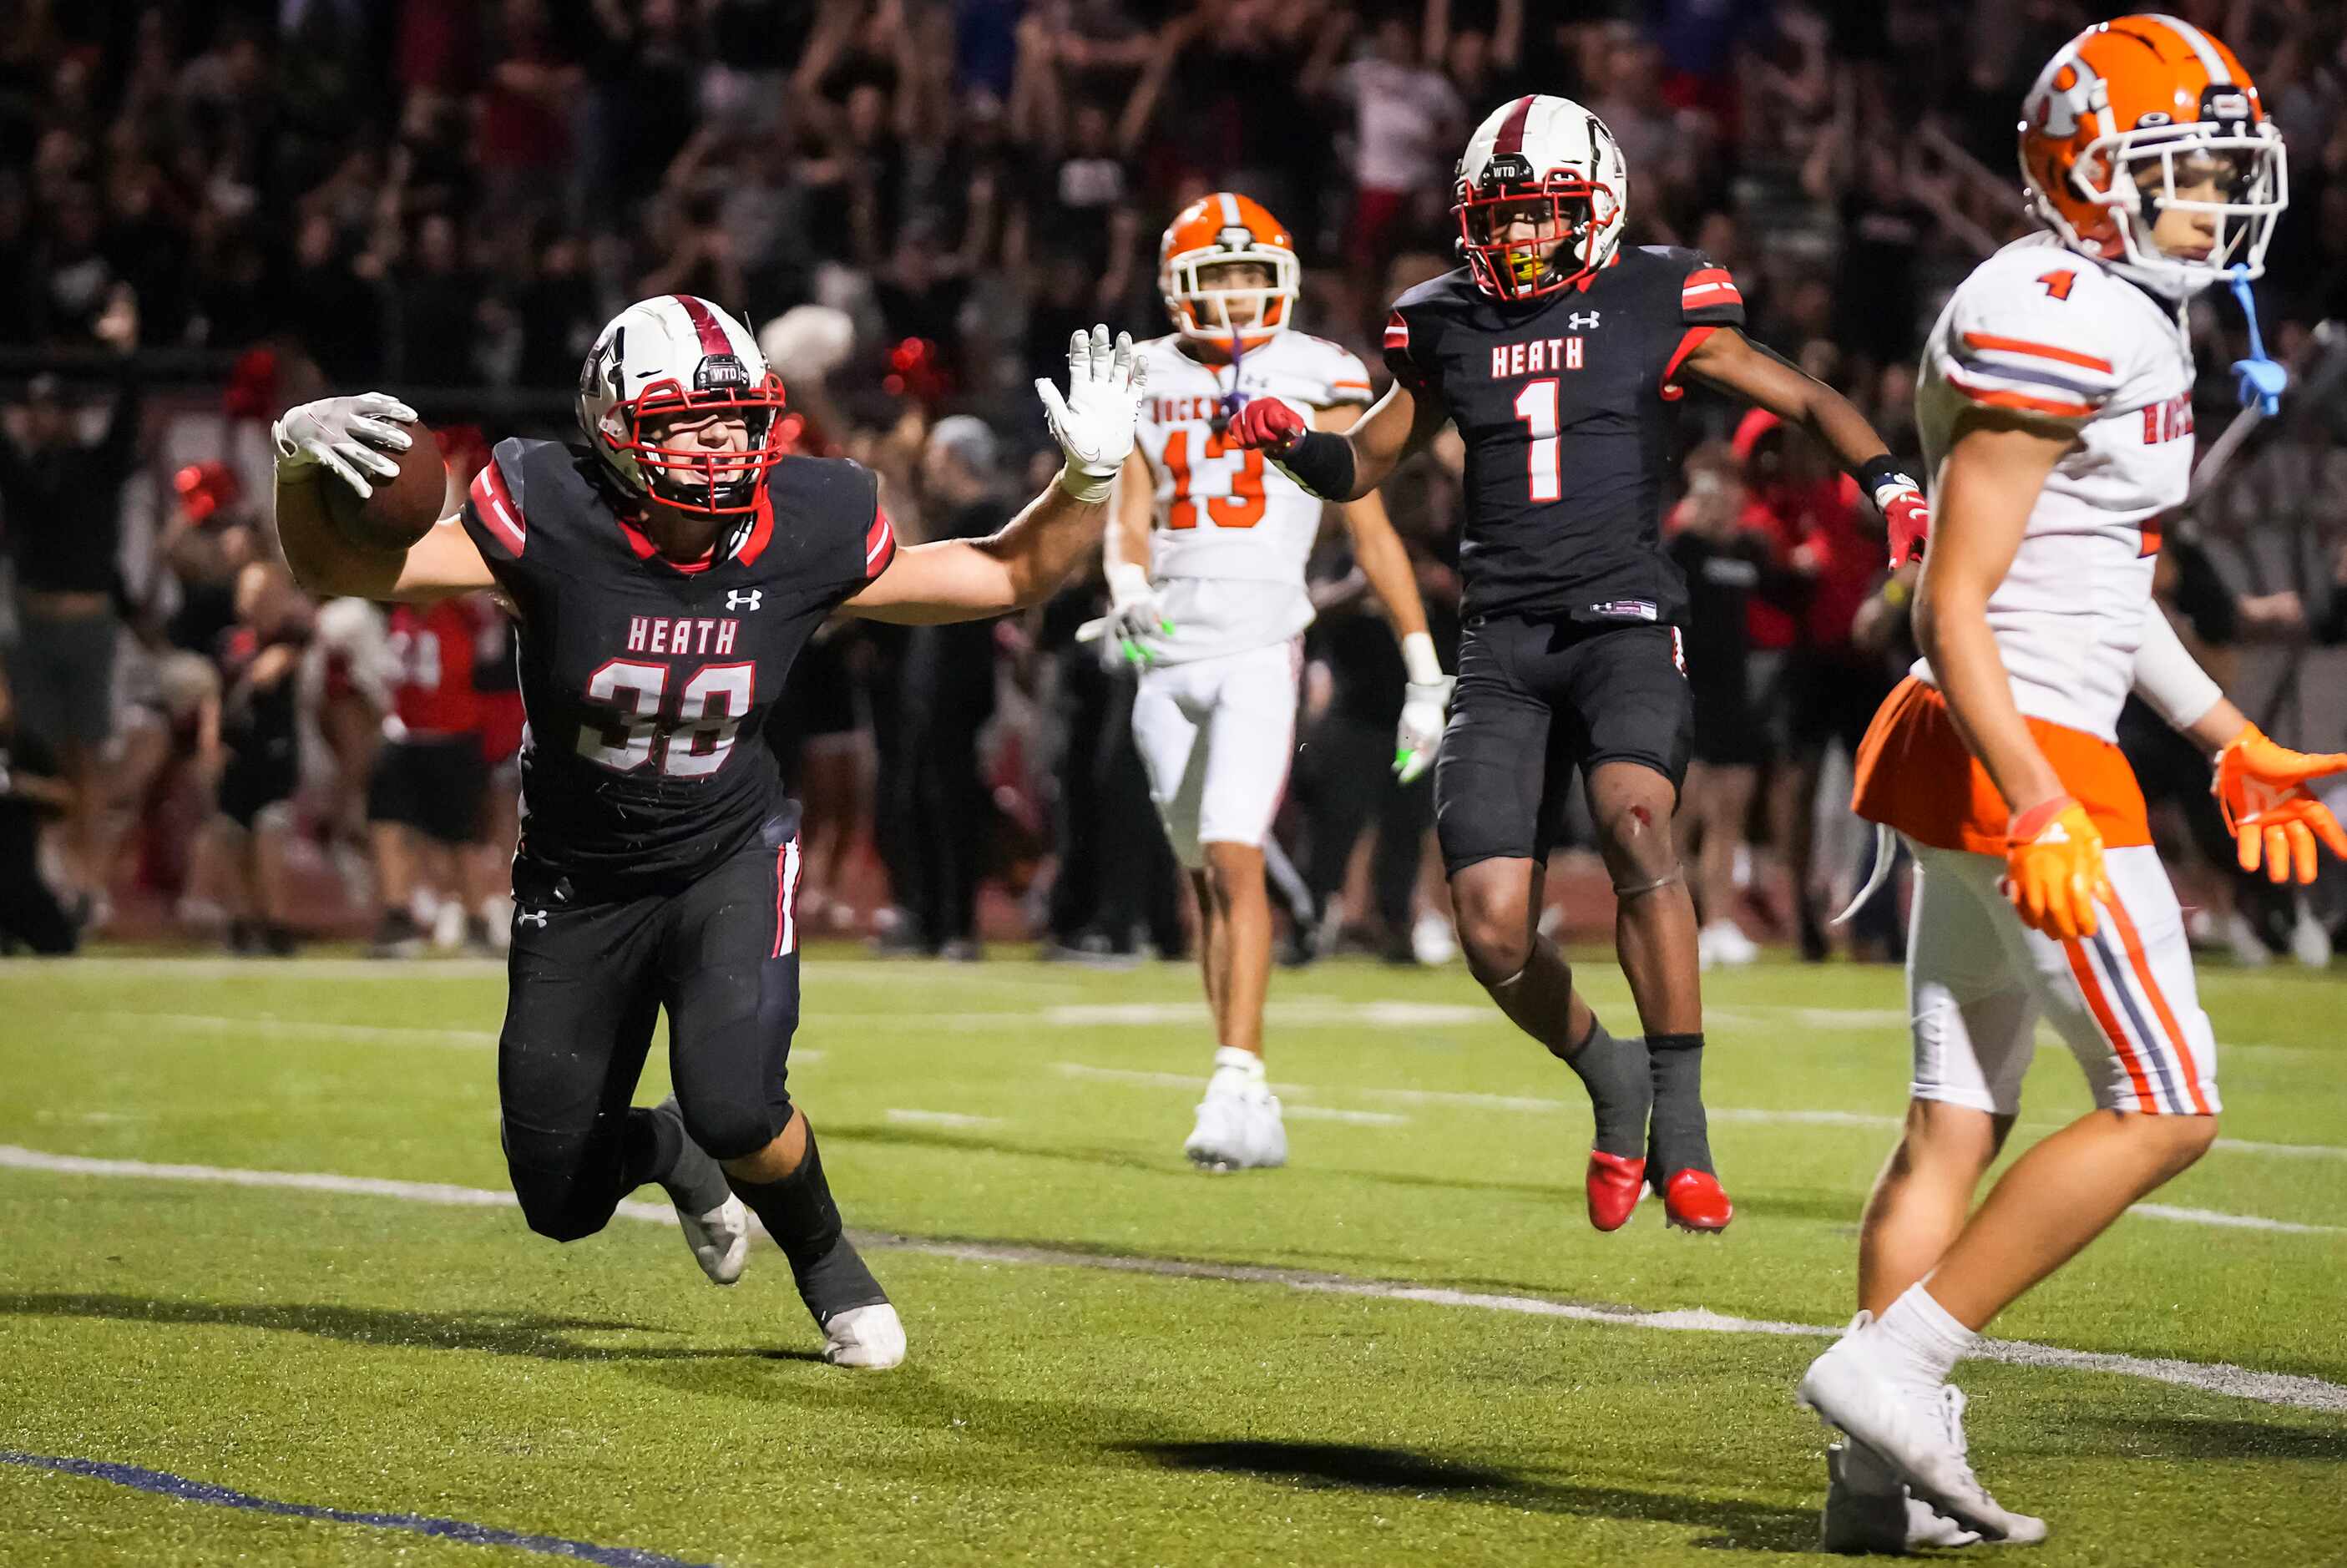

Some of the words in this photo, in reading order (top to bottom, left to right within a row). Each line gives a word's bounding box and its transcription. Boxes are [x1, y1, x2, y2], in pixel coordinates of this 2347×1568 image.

[2036, 269, 2077, 301] 4
[710, 367, 737, 382] WTD
[1490, 336, 1583, 379] HEATH
[1513, 377, 1561, 503] 1
[1163, 430, 1266, 530] 13
[627, 615, 740, 655] HEATH
[574, 656, 756, 779] 38
